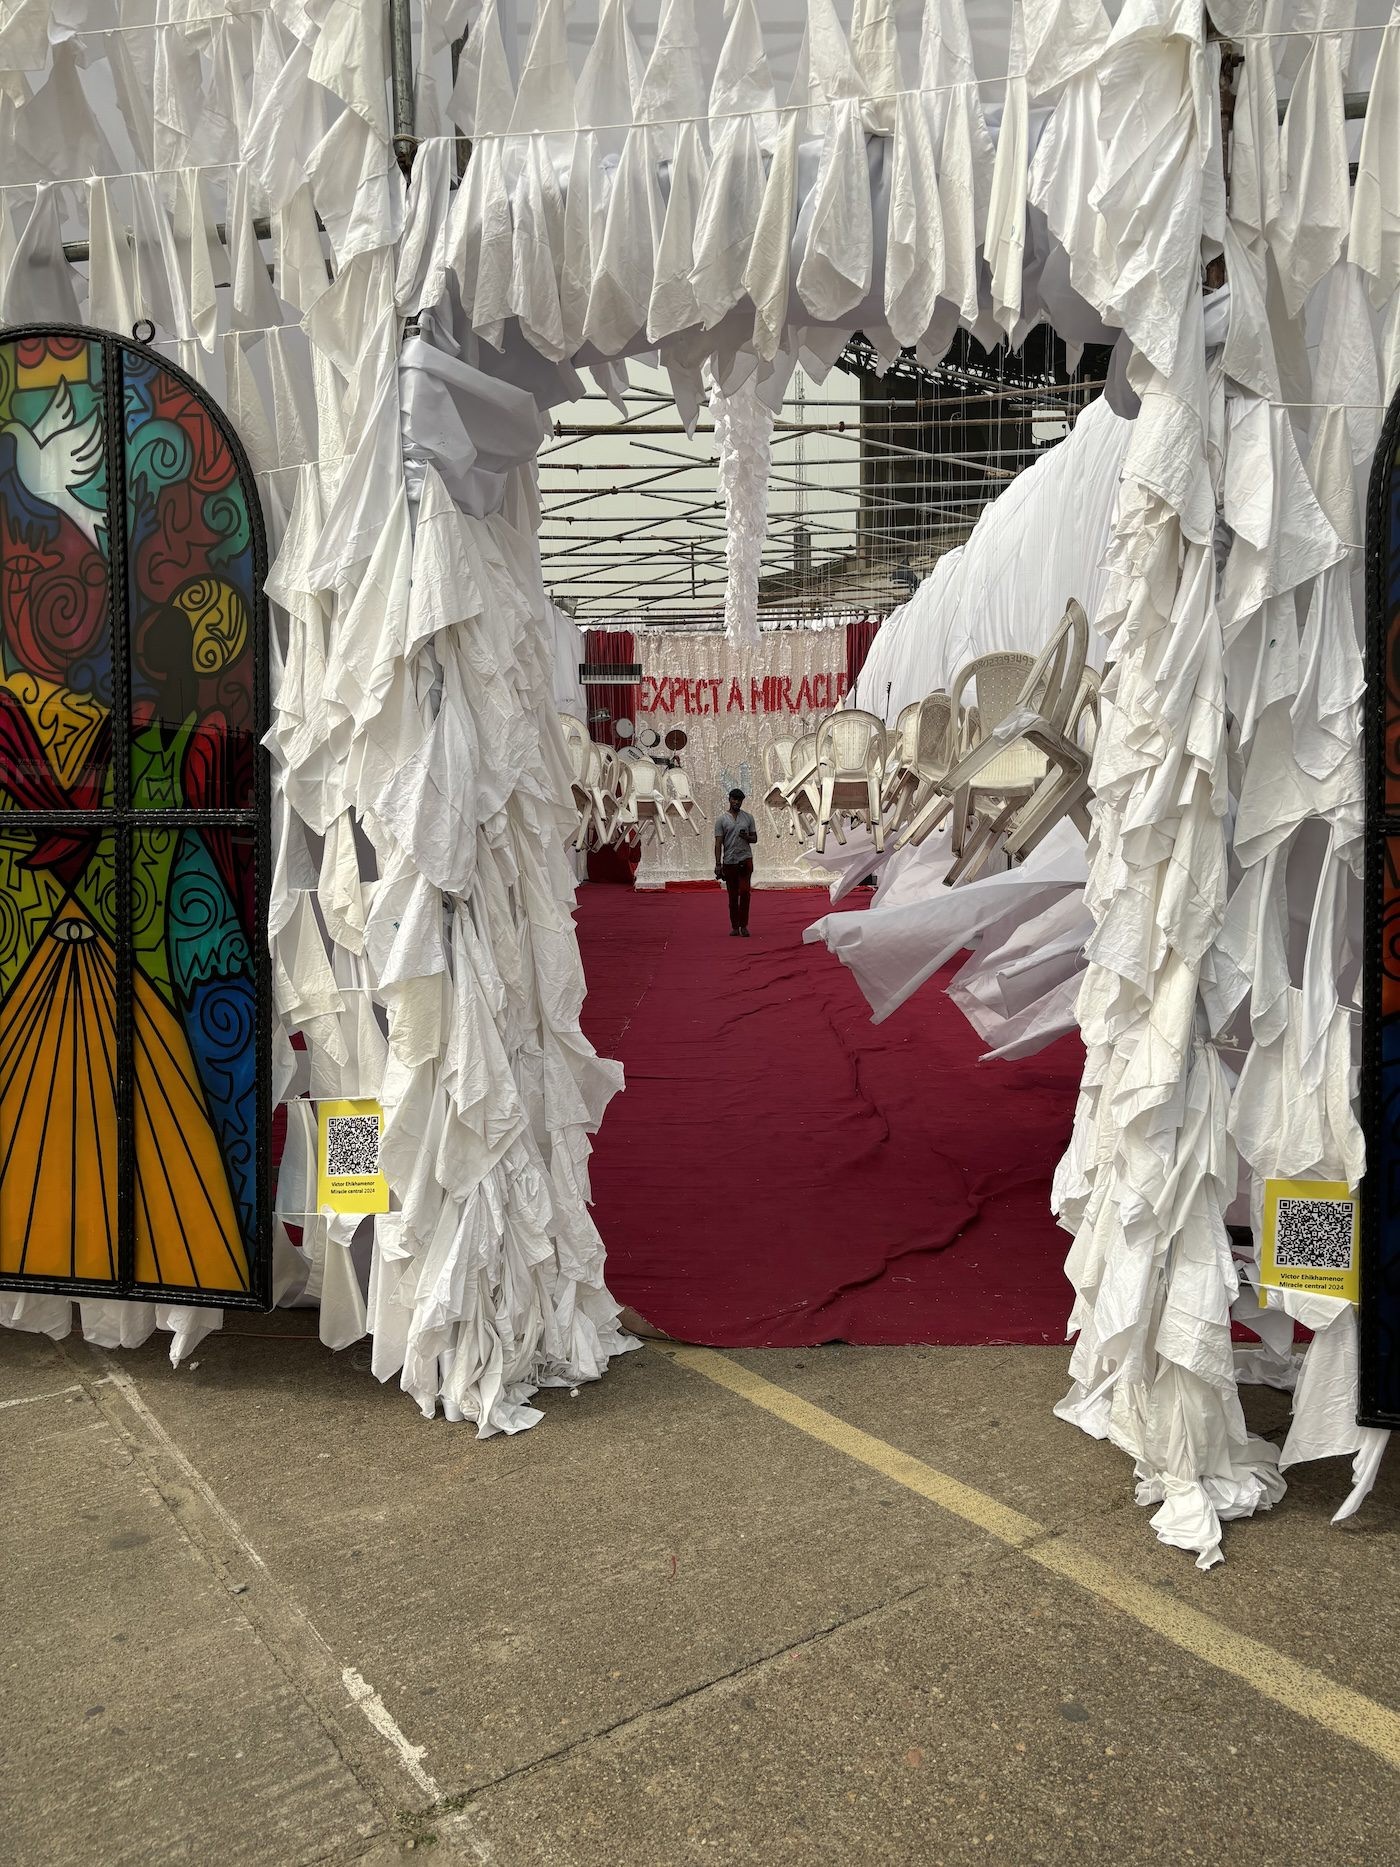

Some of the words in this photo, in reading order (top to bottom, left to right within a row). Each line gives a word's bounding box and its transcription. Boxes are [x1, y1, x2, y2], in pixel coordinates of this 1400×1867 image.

[637, 676, 723, 714] EXPECT
[726, 677, 744, 713] A
[1279, 1281, 1303, 1289] Miracle
